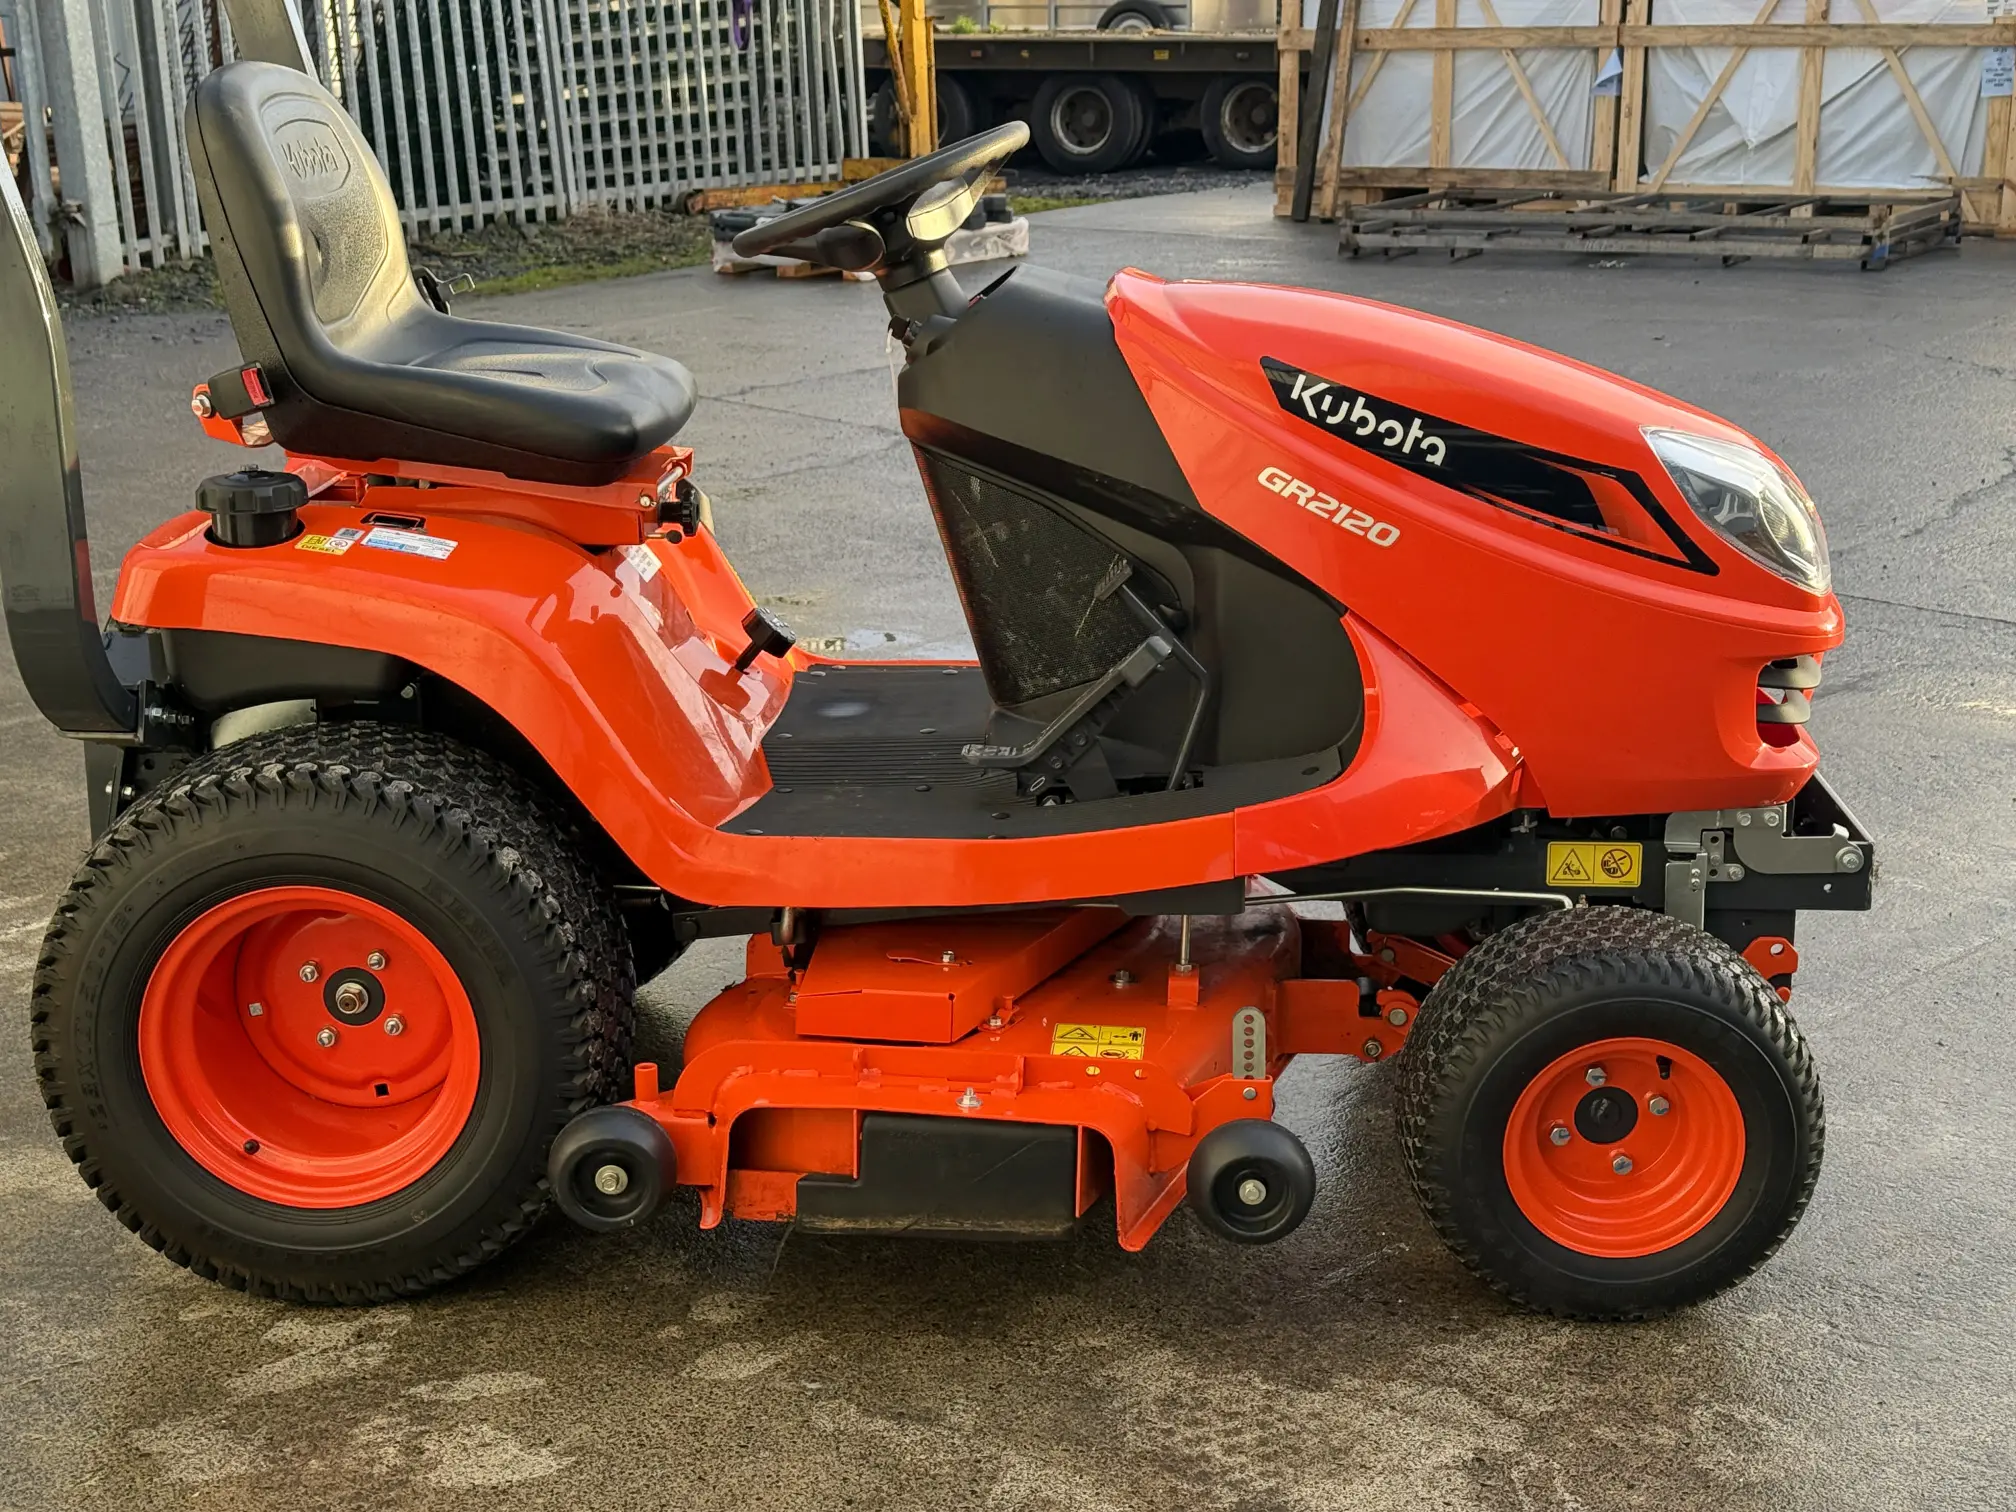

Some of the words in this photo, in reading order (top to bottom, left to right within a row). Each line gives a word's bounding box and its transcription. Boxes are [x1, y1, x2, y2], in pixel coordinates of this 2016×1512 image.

[281, 137, 339, 180] Kubota
[1290, 373, 1447, 467] Kubota
[1257, 466, 1401, 548] GR2120
